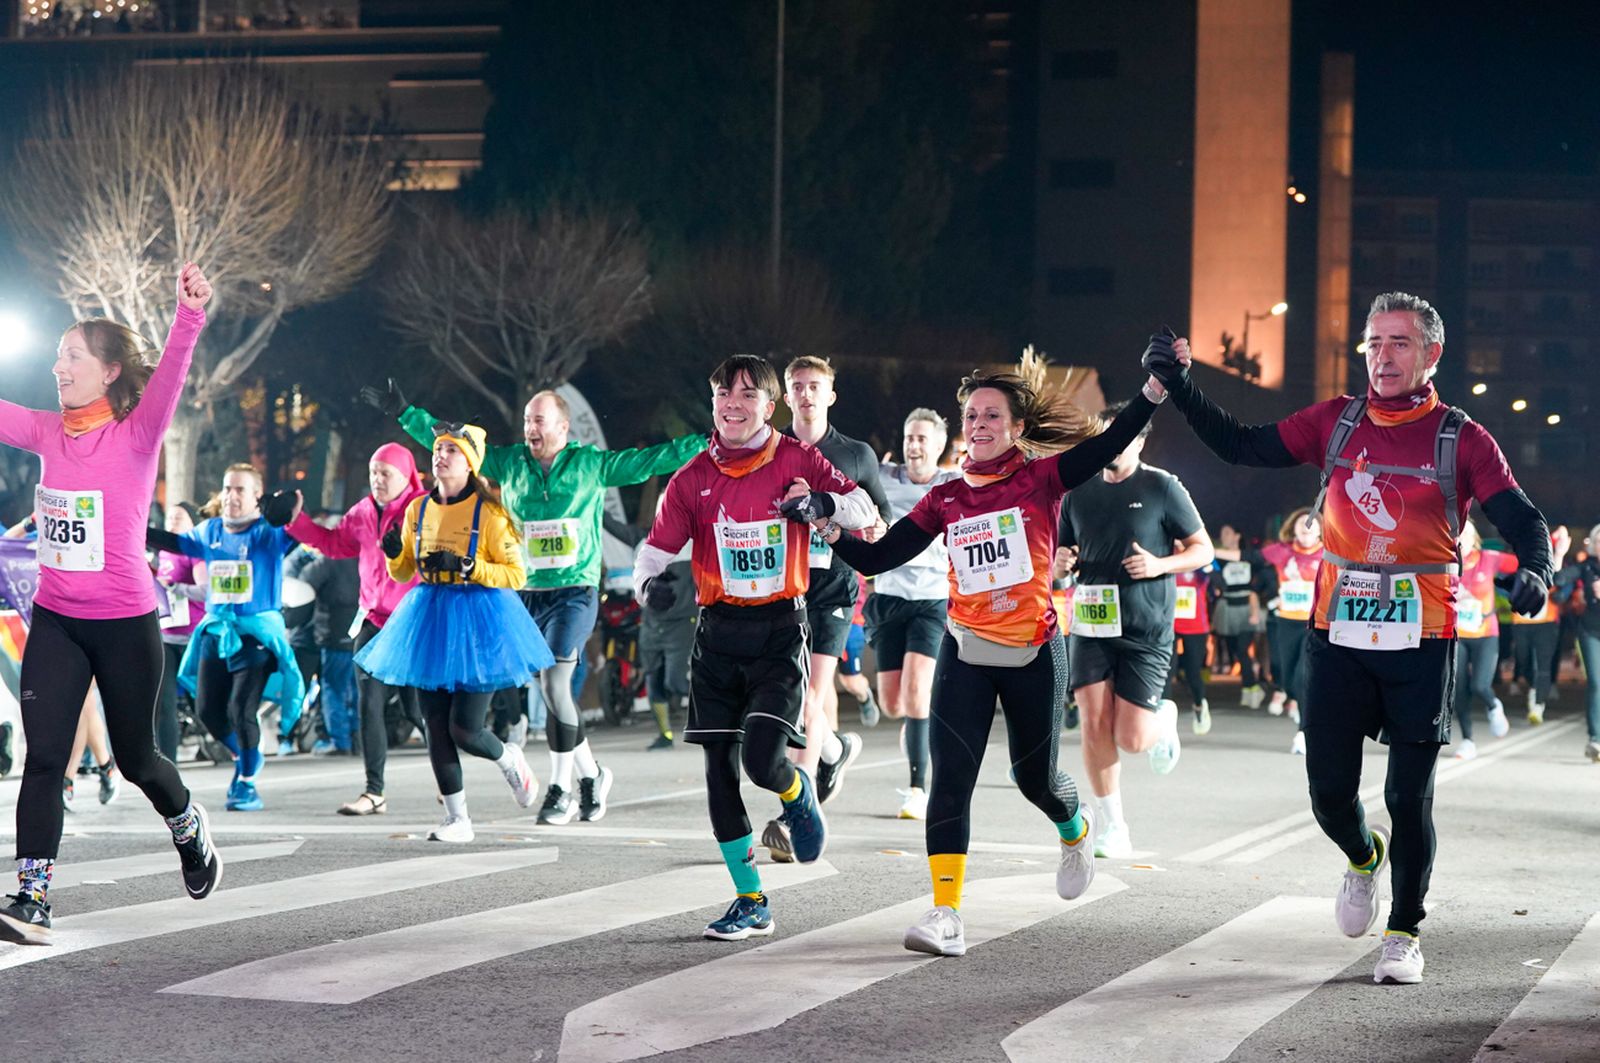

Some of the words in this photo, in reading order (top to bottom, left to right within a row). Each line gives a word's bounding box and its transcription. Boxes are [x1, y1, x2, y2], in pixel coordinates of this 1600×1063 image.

[59, 500, 68, 508] DE
[1358, 491, 1380, 515] 43
[44, 516, 86, 544] 3235
[750, 530, 760, 538] DE
[960, 524, 981, 536] NOCHE
[982, 521, 991, 531] DE
[540, 537, 564, 552] 218
[736, 540, 762, 548] ANTON
[954, 536, 968, 547] SAN
[969, 531, 993, 544] ANTON
[963, 538, 1011, 568] 7704
[1350, 580, 1376, 590] NOCHE
[1340, 589, 1357, 597] SAN
[1359, 590, 1380, 598] ANTO
[1344, 598, 1407, 623] 12221
